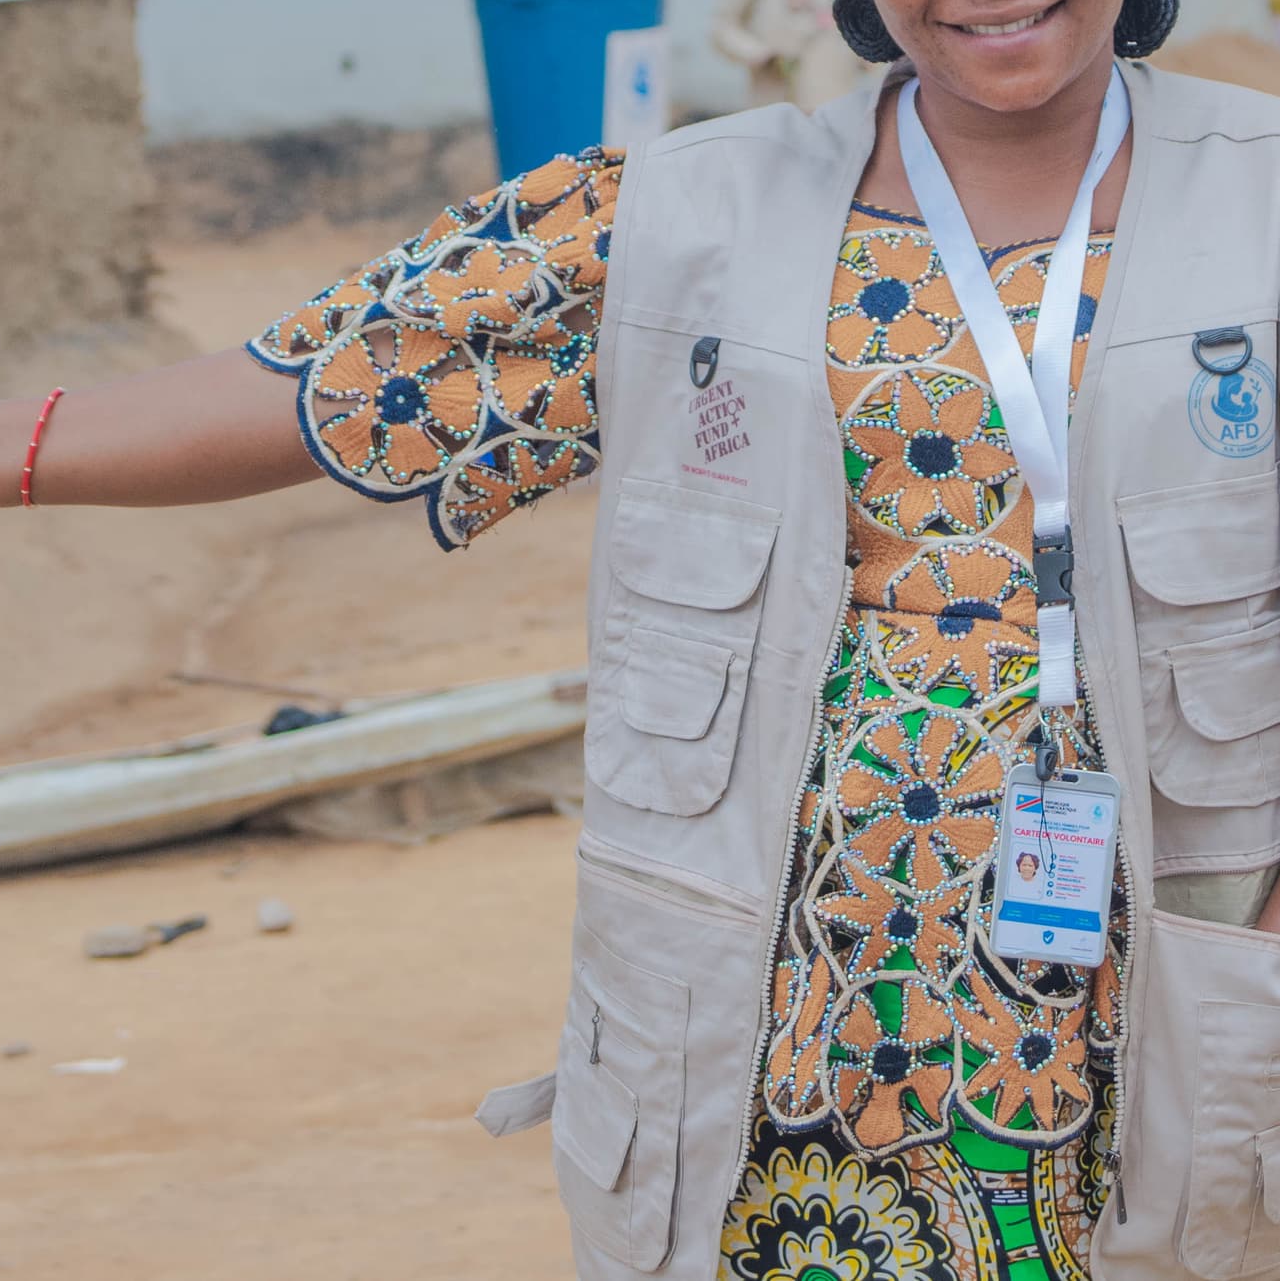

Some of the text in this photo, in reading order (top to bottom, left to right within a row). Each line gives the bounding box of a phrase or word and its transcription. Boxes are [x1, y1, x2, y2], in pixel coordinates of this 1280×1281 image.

[694, 421, 729, 449] FUND
[1221, 422, 1259, 441] AFD
[705, 431, 750, 464] AFRICA
[1014, 828, 1041, 838] CARTE
[1054, 832, 1105, 846] VOLONTAIRE
